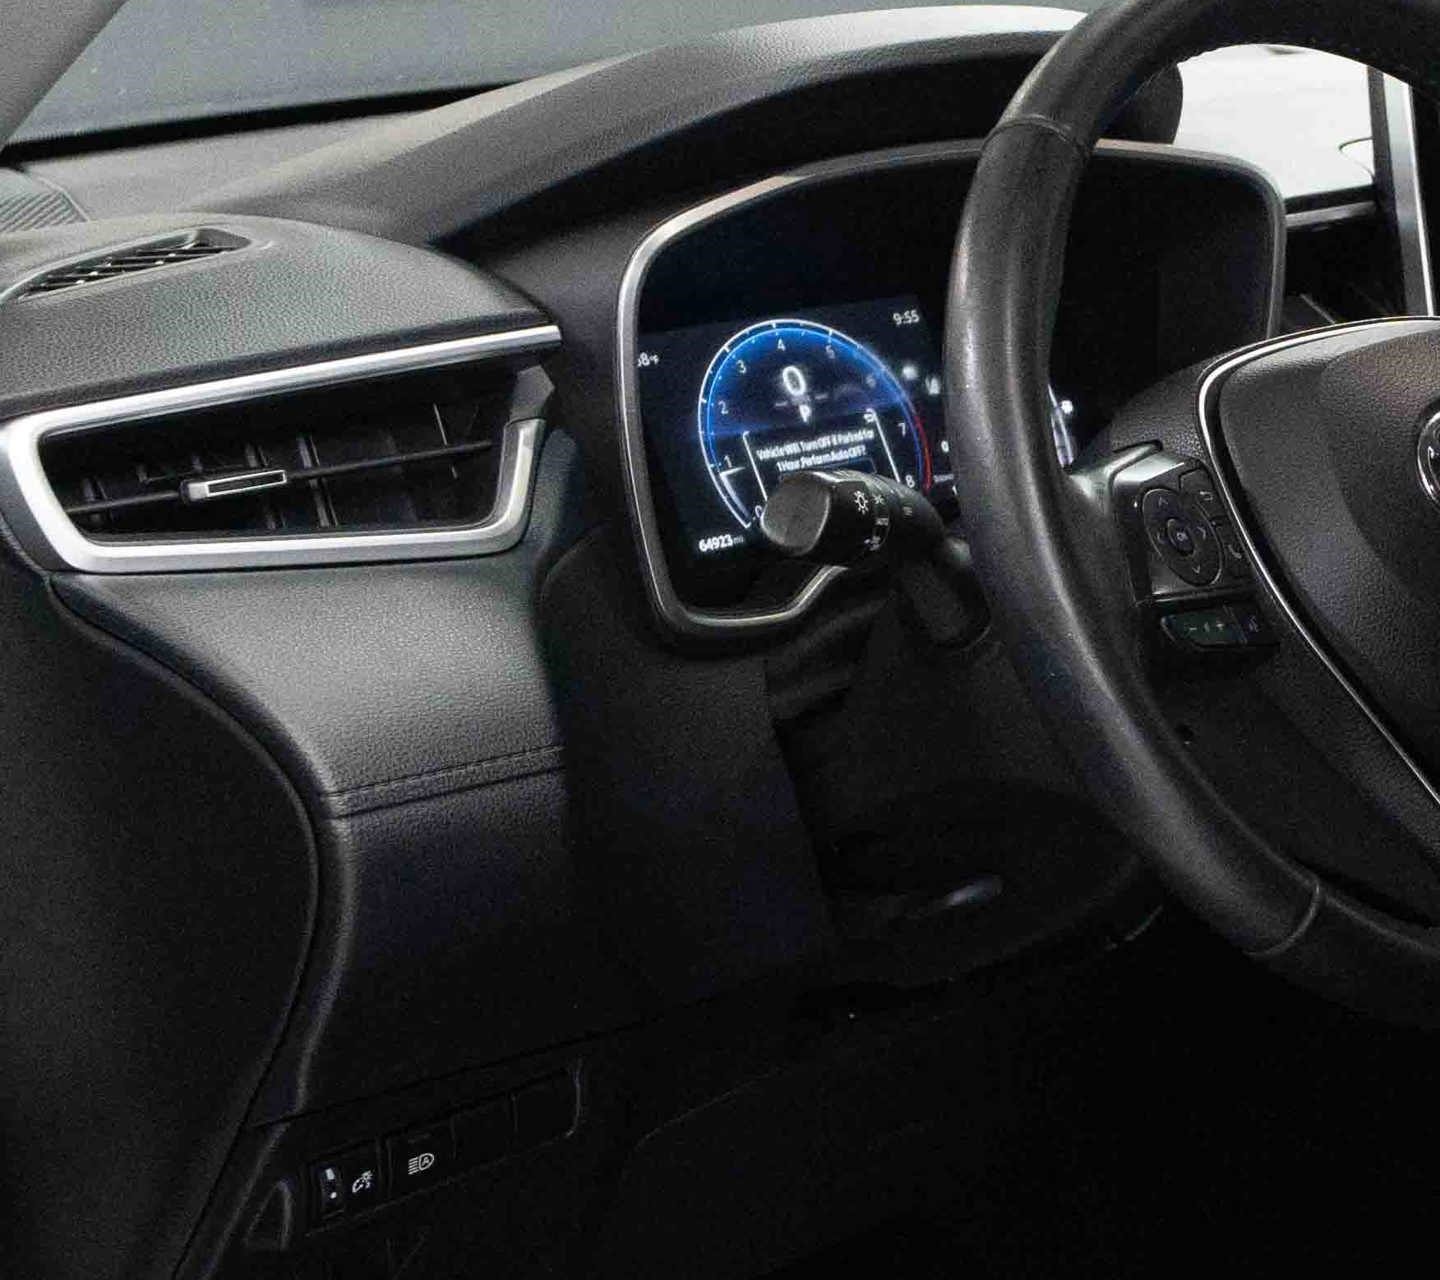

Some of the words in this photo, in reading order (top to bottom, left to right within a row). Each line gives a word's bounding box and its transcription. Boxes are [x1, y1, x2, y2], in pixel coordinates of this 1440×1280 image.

[893, 310, 920, 325] 9:55
[776, 338, 786, 352] 4
[736, 360, 747, 374] 3
[782, 365, 807, 397] 0
[718, 401, 729, 415] 2
[898, 422, 906, 436] 7
[905, 474, 915, 488] 8
